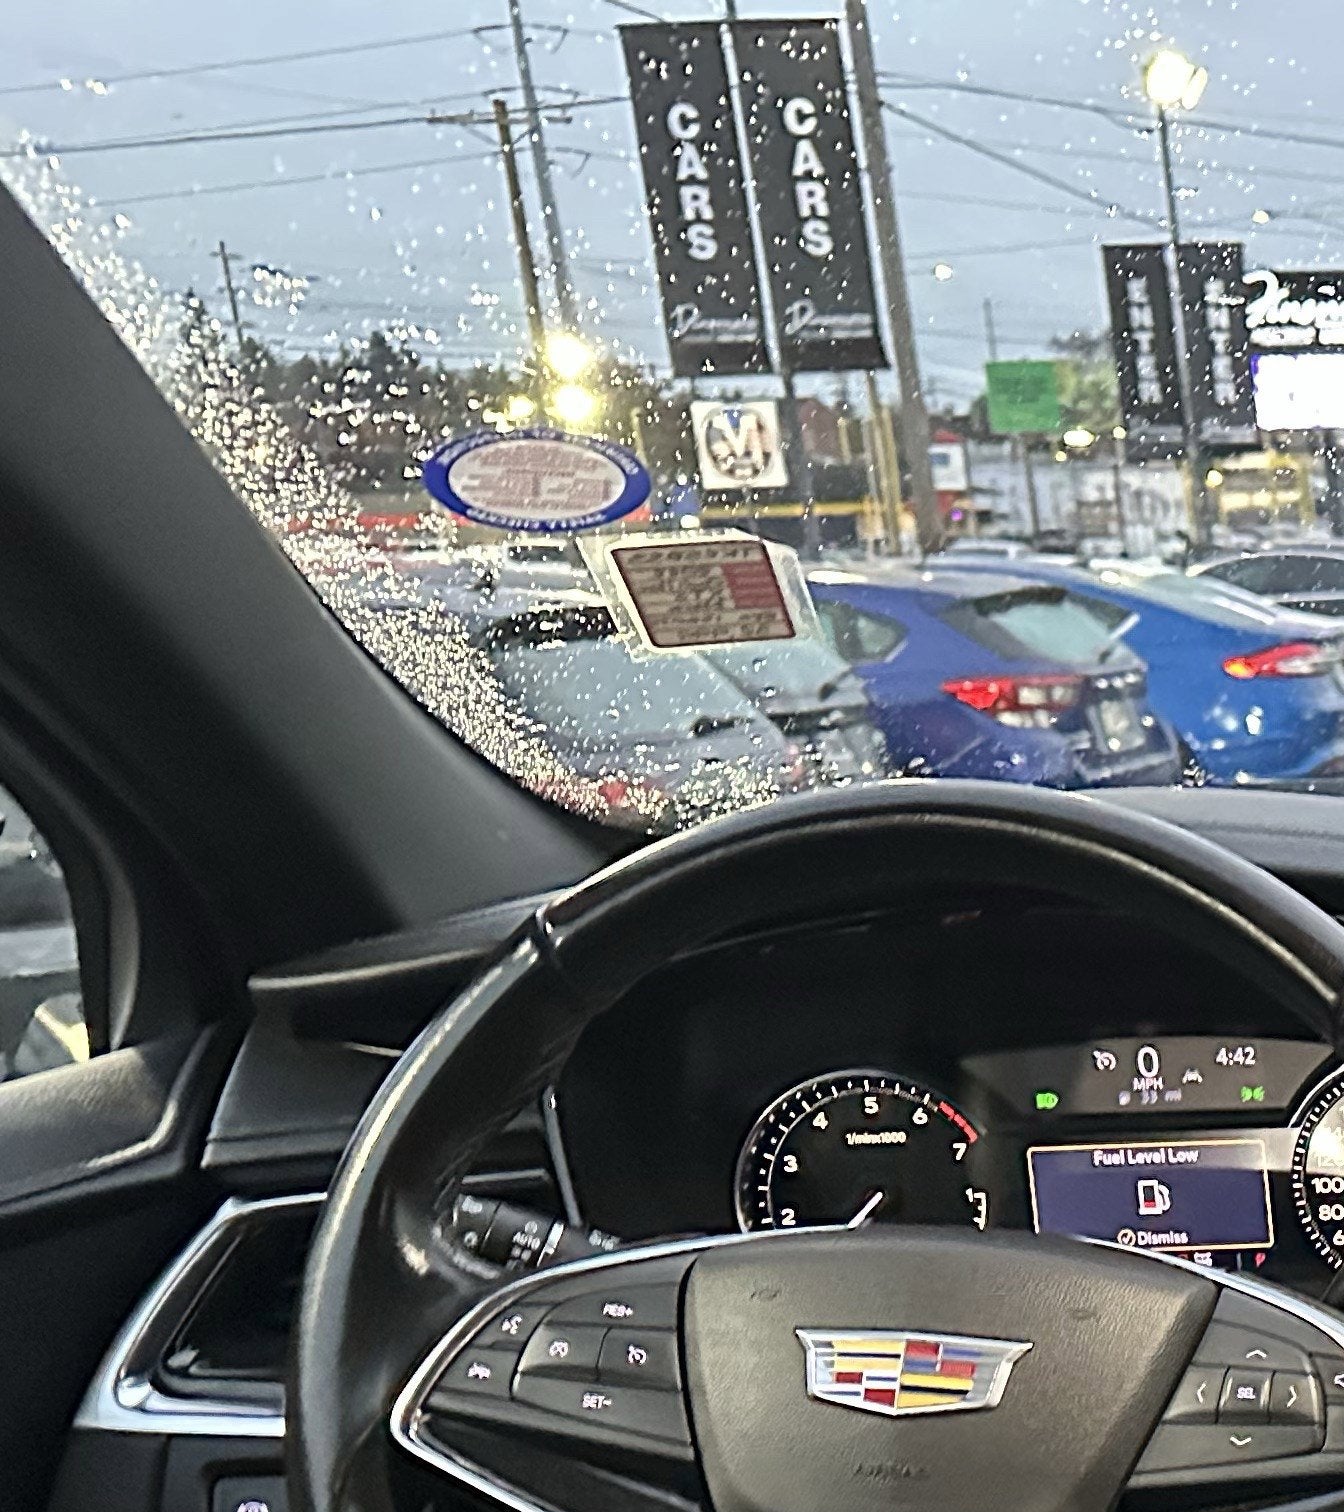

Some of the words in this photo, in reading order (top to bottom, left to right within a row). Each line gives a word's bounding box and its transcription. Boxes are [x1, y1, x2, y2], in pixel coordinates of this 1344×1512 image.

[666, 101, 718, 261] CARS
[783, 96, 834, 257] CARS
[1137, 1047, 1159, 1078] 0
[1215, 1047, 1256, 1066] 4:42
[1133, 1077, 1163, 1091] MPH
[864, 1097, 878, 1114] 5
[813, 1112, 828, 1129] 4
[913, 1108, 928, 1125] 6
[952, 1143, 966, 1160] 7
[1093, 1150, 1125, 1166] Fuel
[1127, 1148, 1166, 1165] Level
[1168, 1147, 1199, 1163] Low
[783, 1155, 798, 1173] 3
[1311, 1177, 1344, 1194] 100
[781, 1208, 796, 1226] 2
[1318, 1203, 1344, 1221] 80
[1137, 1230, 1188, 1244] Dismiss
